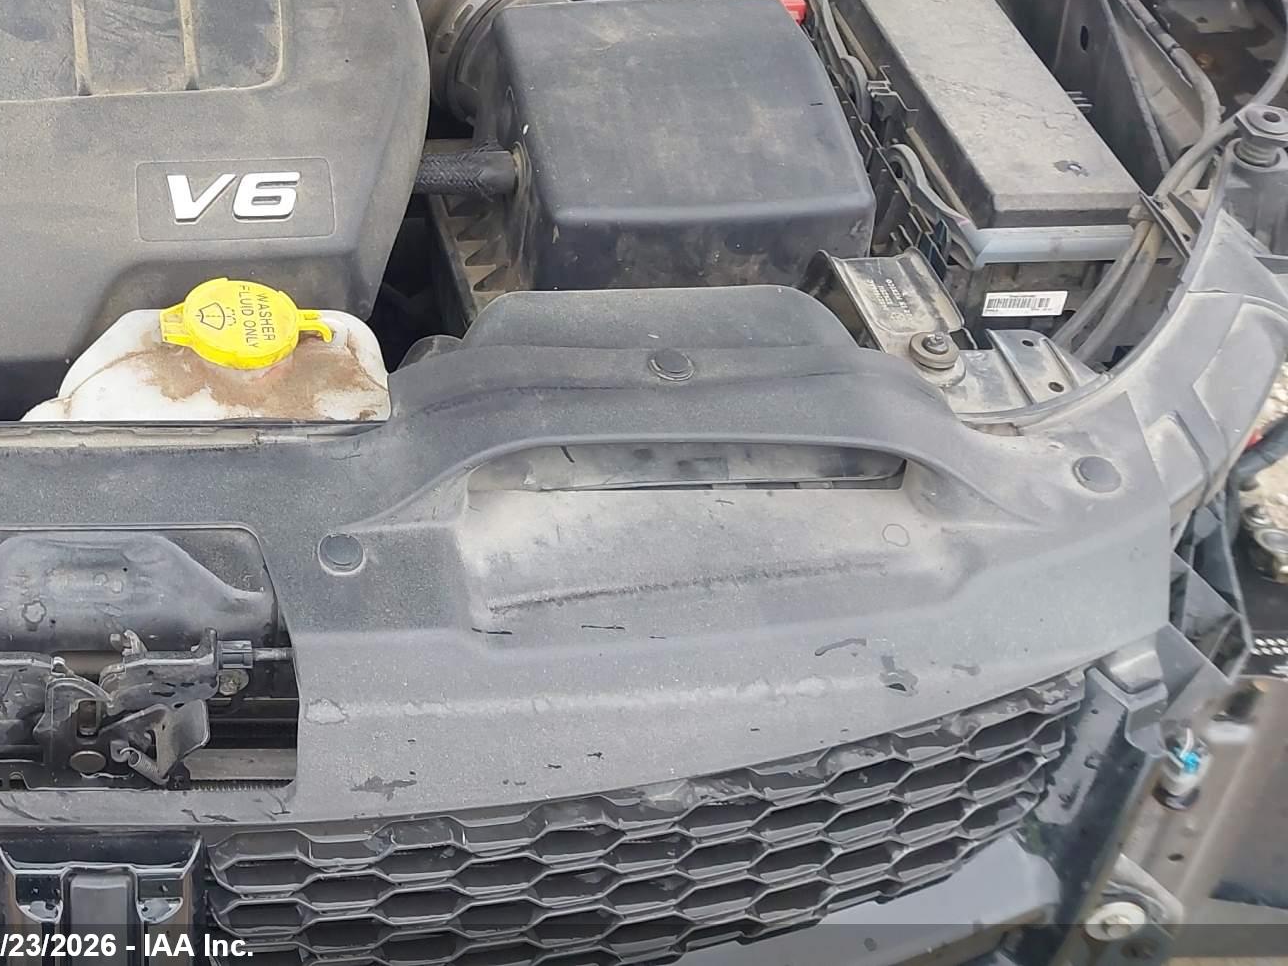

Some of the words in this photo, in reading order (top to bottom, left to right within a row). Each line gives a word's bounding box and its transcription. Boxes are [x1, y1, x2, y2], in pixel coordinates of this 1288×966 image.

[166, 172, 301, 224] V6
[239, 284, 255, 317] FLUID
[255, 292, 276, 341] WASHER
[243, 320, 259, 348] ONLY
